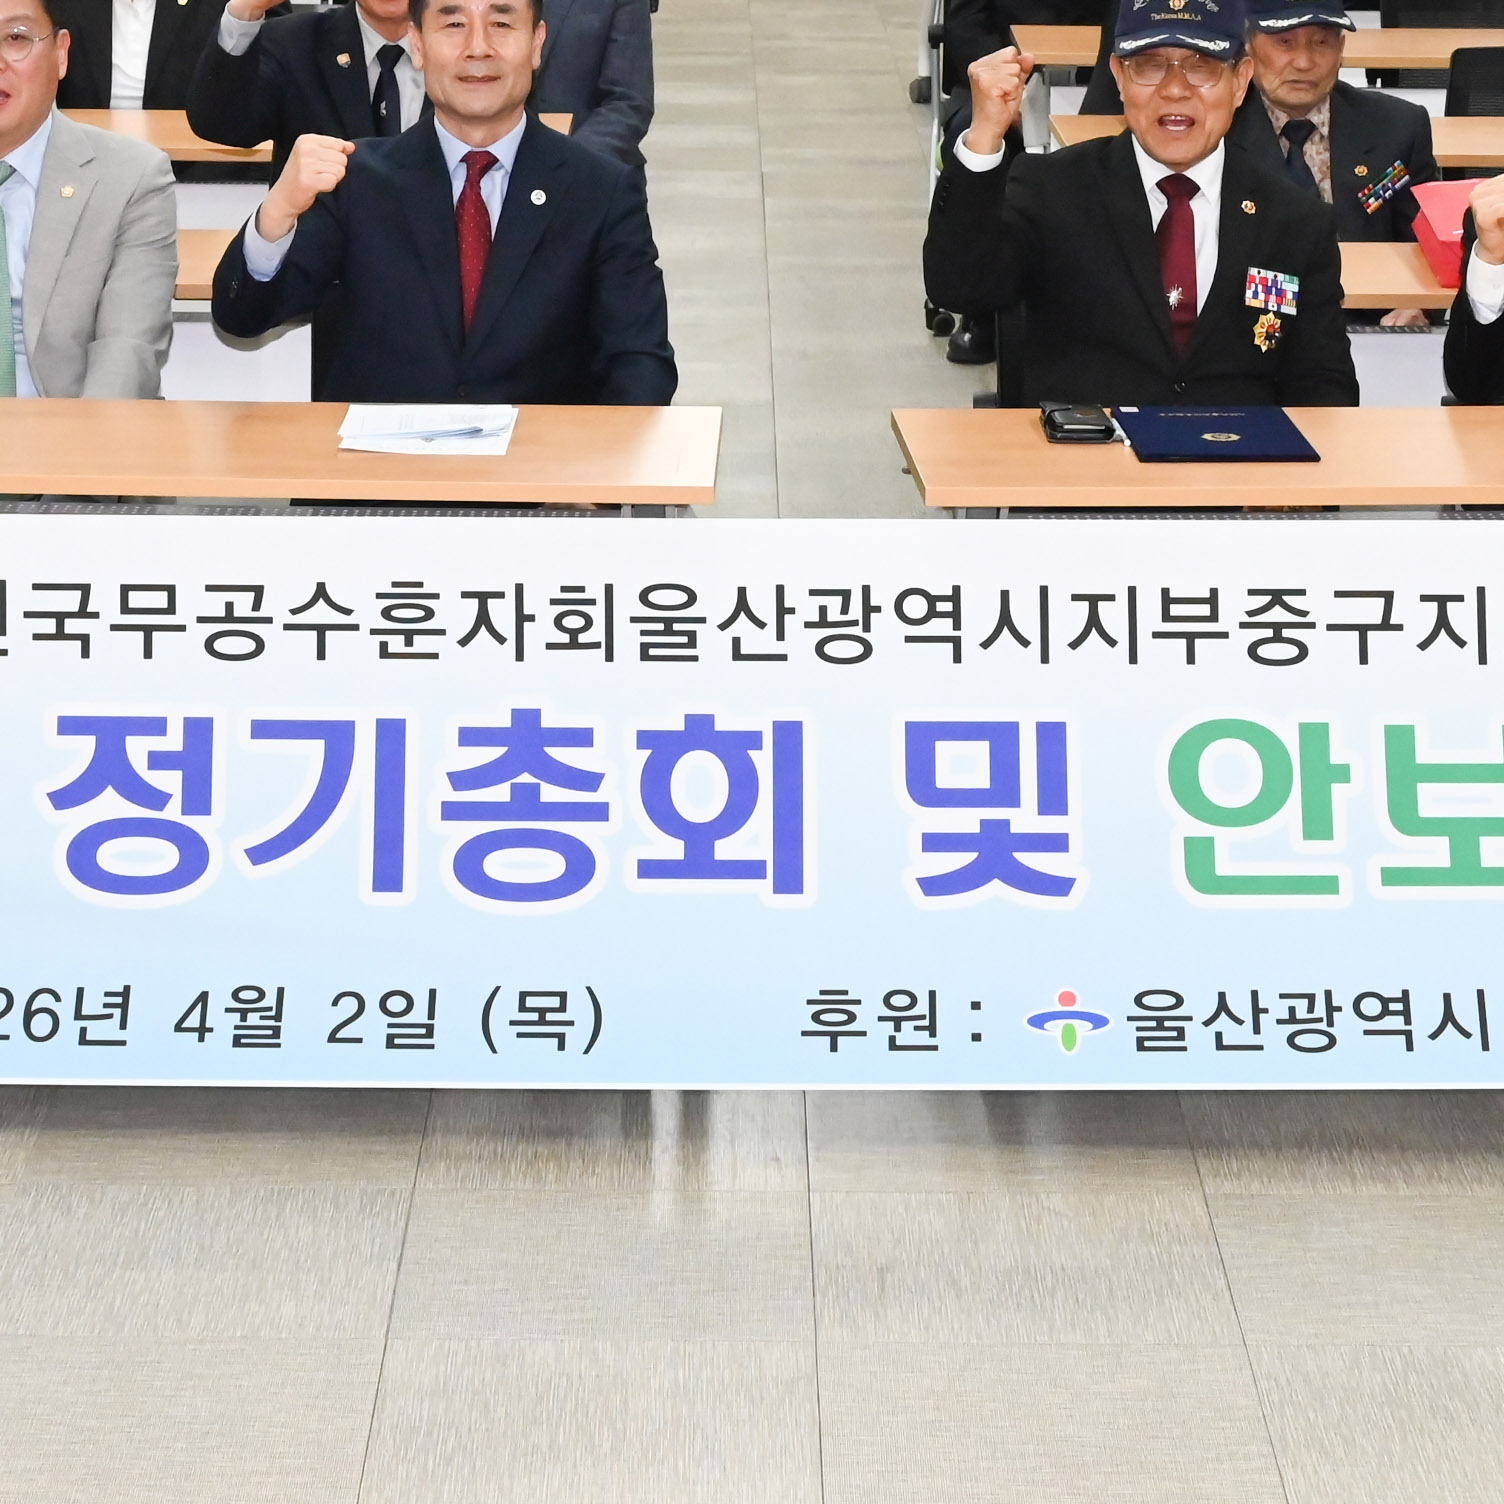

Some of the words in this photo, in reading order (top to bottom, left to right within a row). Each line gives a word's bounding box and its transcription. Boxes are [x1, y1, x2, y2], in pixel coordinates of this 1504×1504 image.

[46, 707, 805, 904] 정기총회
[904, 720, 1077, 898] 및
[172, 984, 286, 1050] 4월
[326, 989, 438, 1051] 2일
[480, 984, 603, 1056] (목)
[1125, 988, 1491, 1054] 울산광역시
